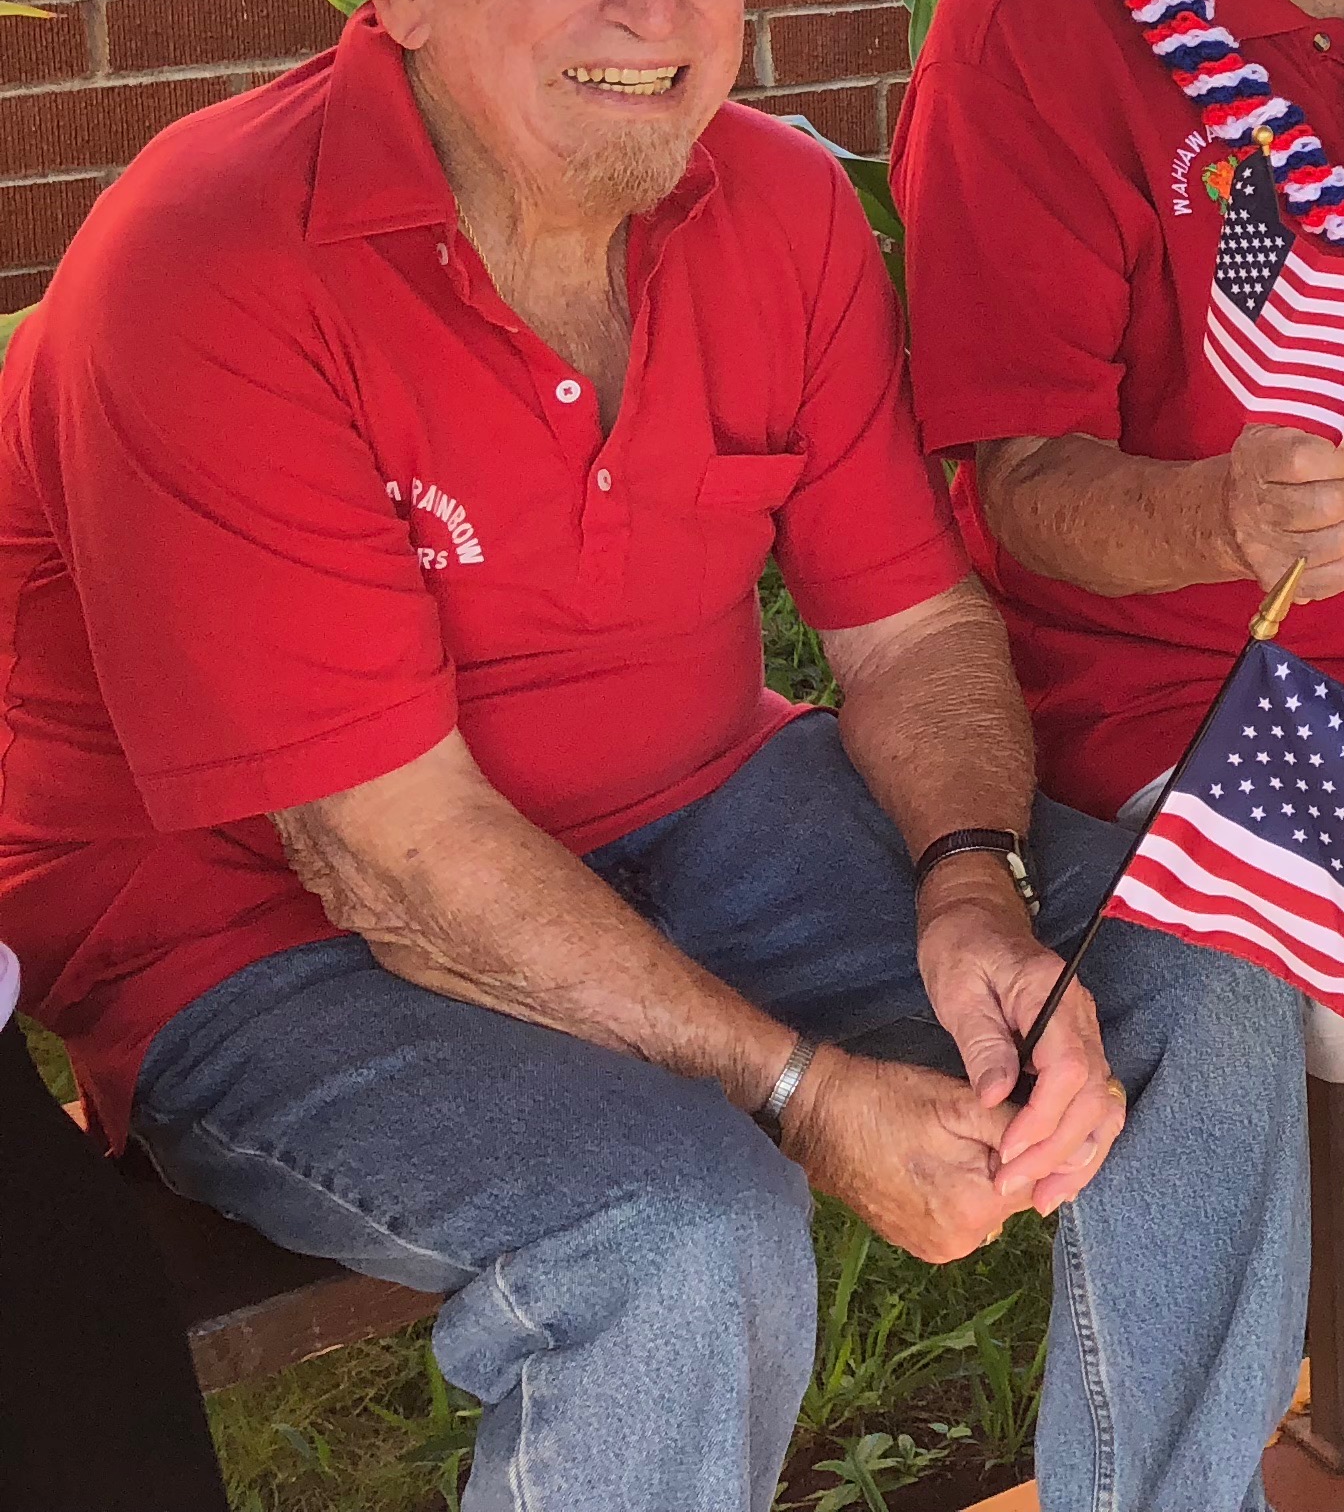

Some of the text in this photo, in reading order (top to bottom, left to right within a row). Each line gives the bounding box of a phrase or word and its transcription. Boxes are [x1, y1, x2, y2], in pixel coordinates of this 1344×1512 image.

[1171, 124, 1217, 216] WAHIAWA
[411, 476, 485, 564] RAINBOW
[417, 547, 449, 570] RS
